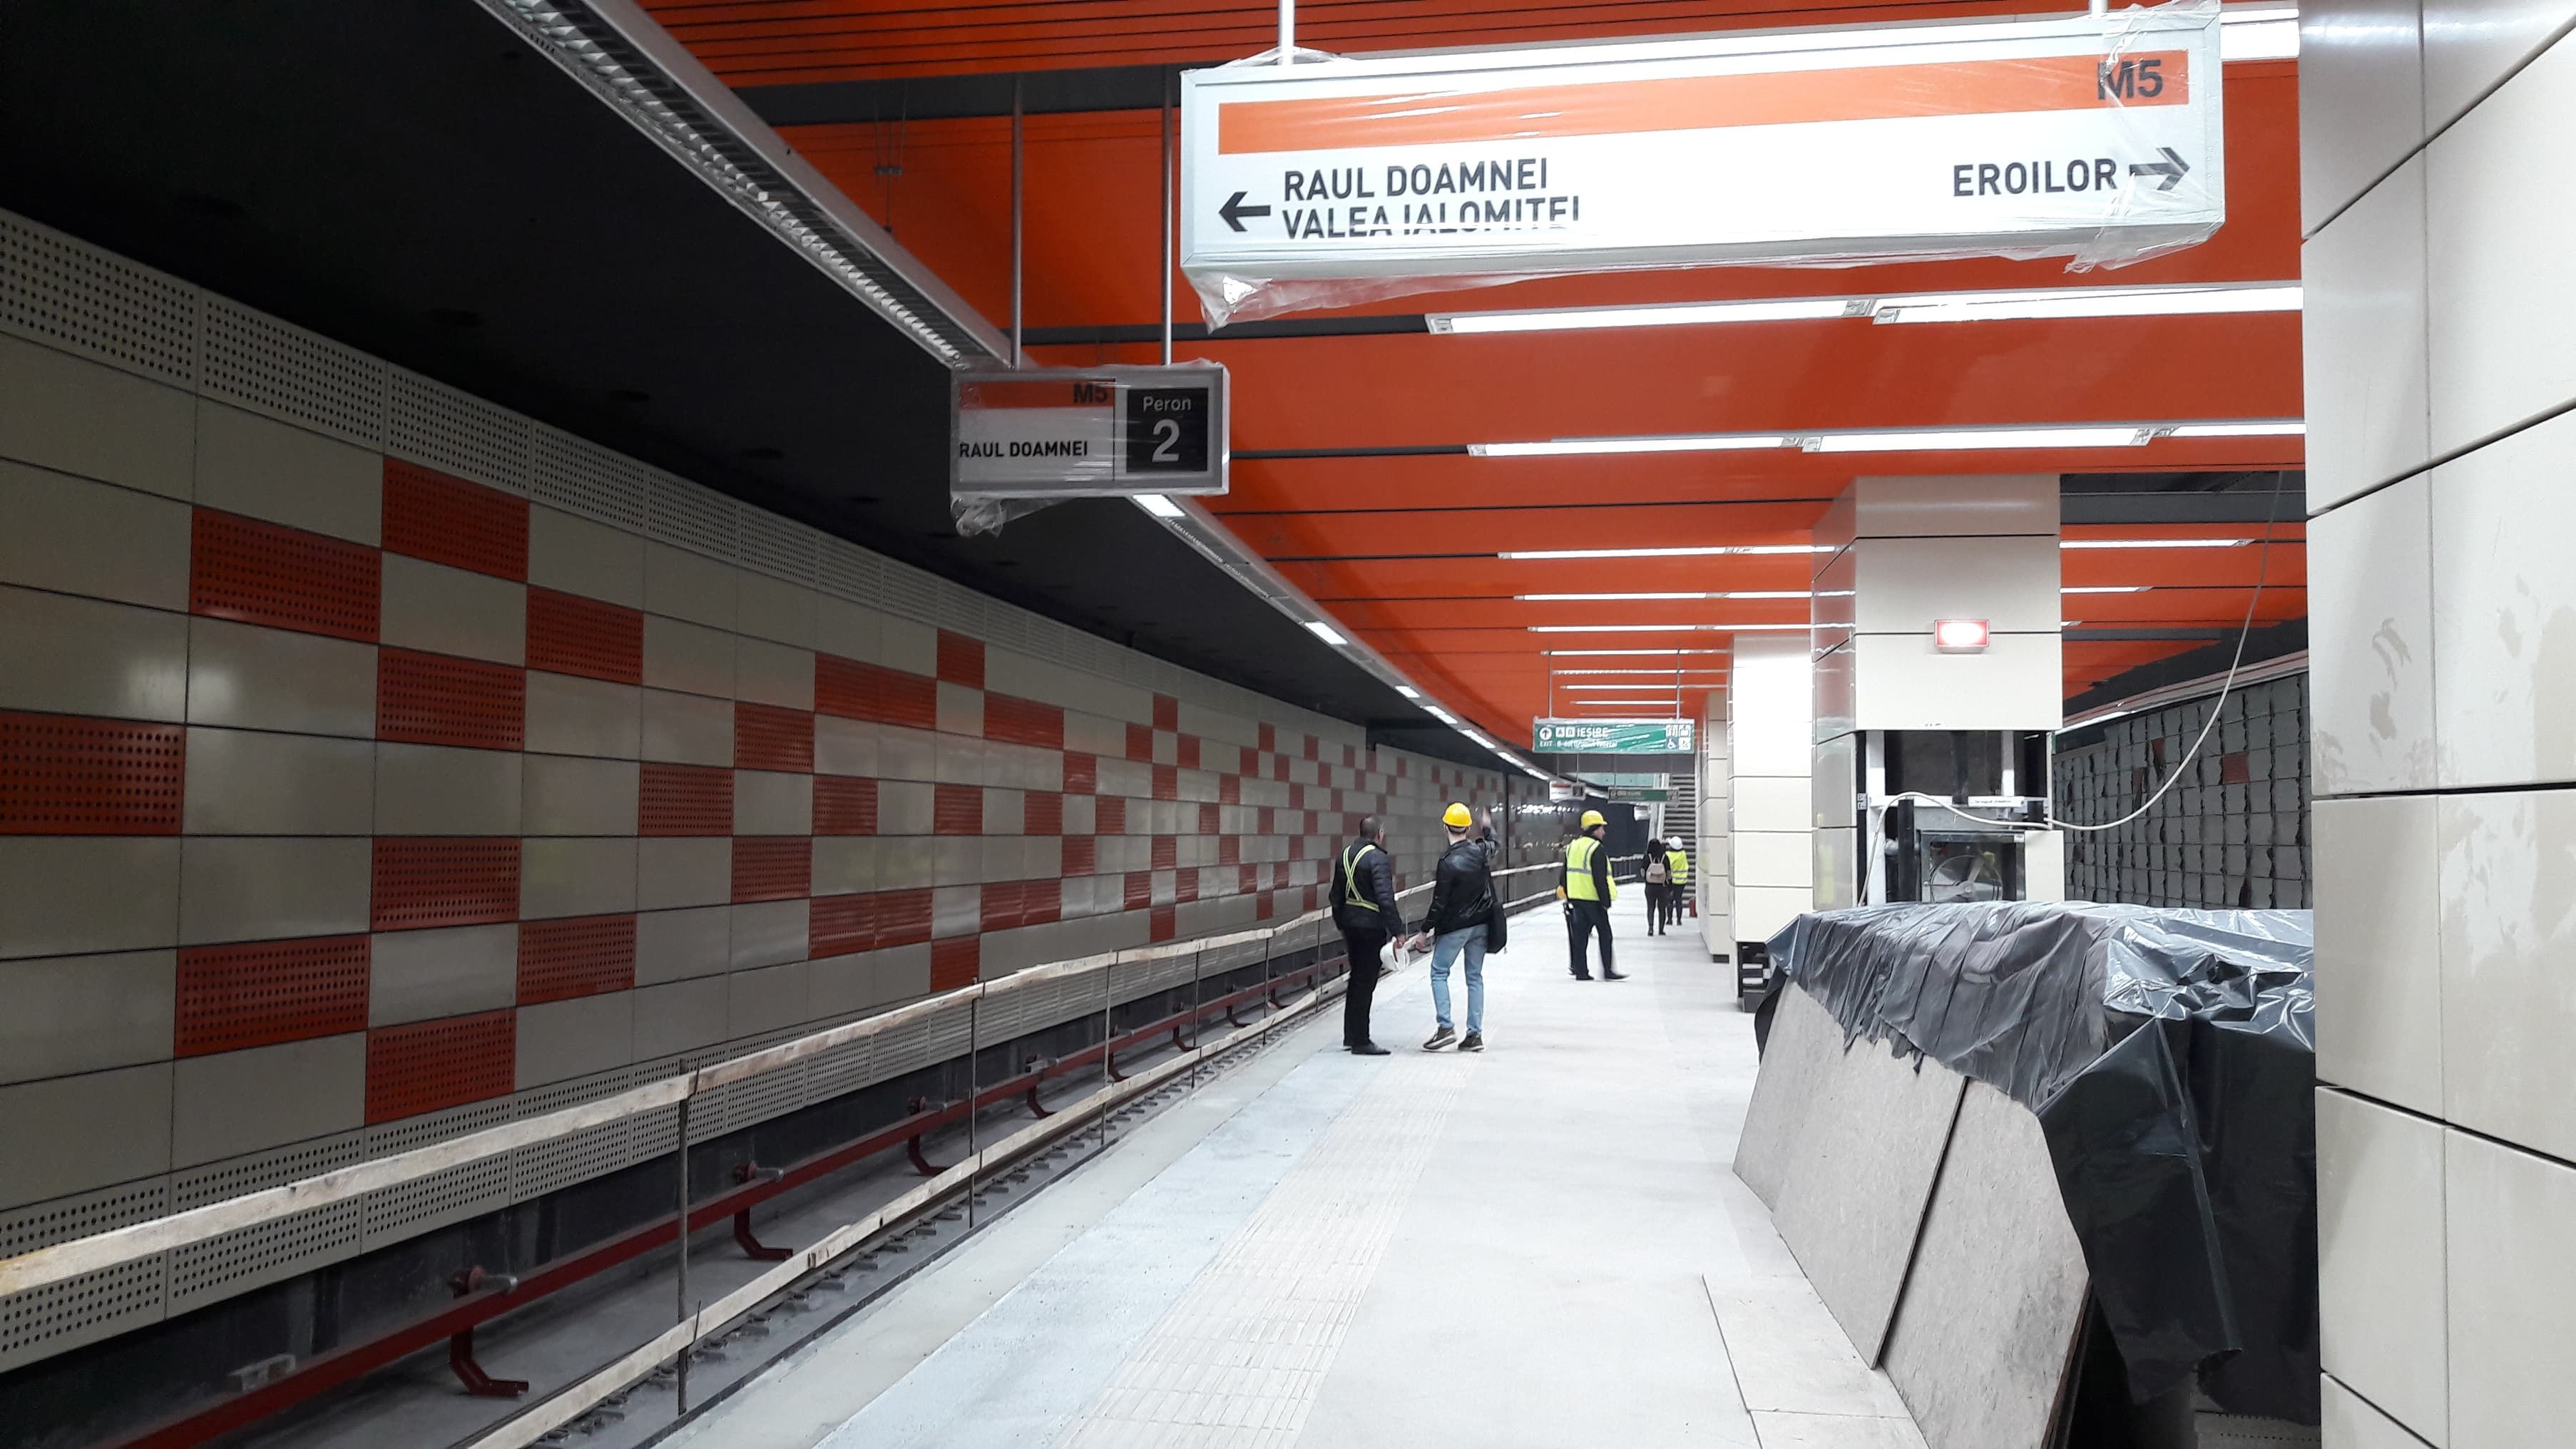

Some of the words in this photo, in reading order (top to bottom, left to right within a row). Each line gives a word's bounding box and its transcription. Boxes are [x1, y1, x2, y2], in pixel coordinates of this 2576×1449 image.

[2097, 59, 2163, 100] M5
[1284, 167, 1375, 201] RAUL
[1386, 158, 1548, 197] DOAMNEI
[1953, 158, 2118, 197] EROILOR
[1282, 205, 1393, 240] VALEA
[1073, 383, 1108, 404] M5
[1143, 396, 1192, 411] Peron
[959, 442, 1004, 458] RAUL
[1010, 441, 1088, 457] DOAMNEI
[1152, 418, 1181, 463] 2
